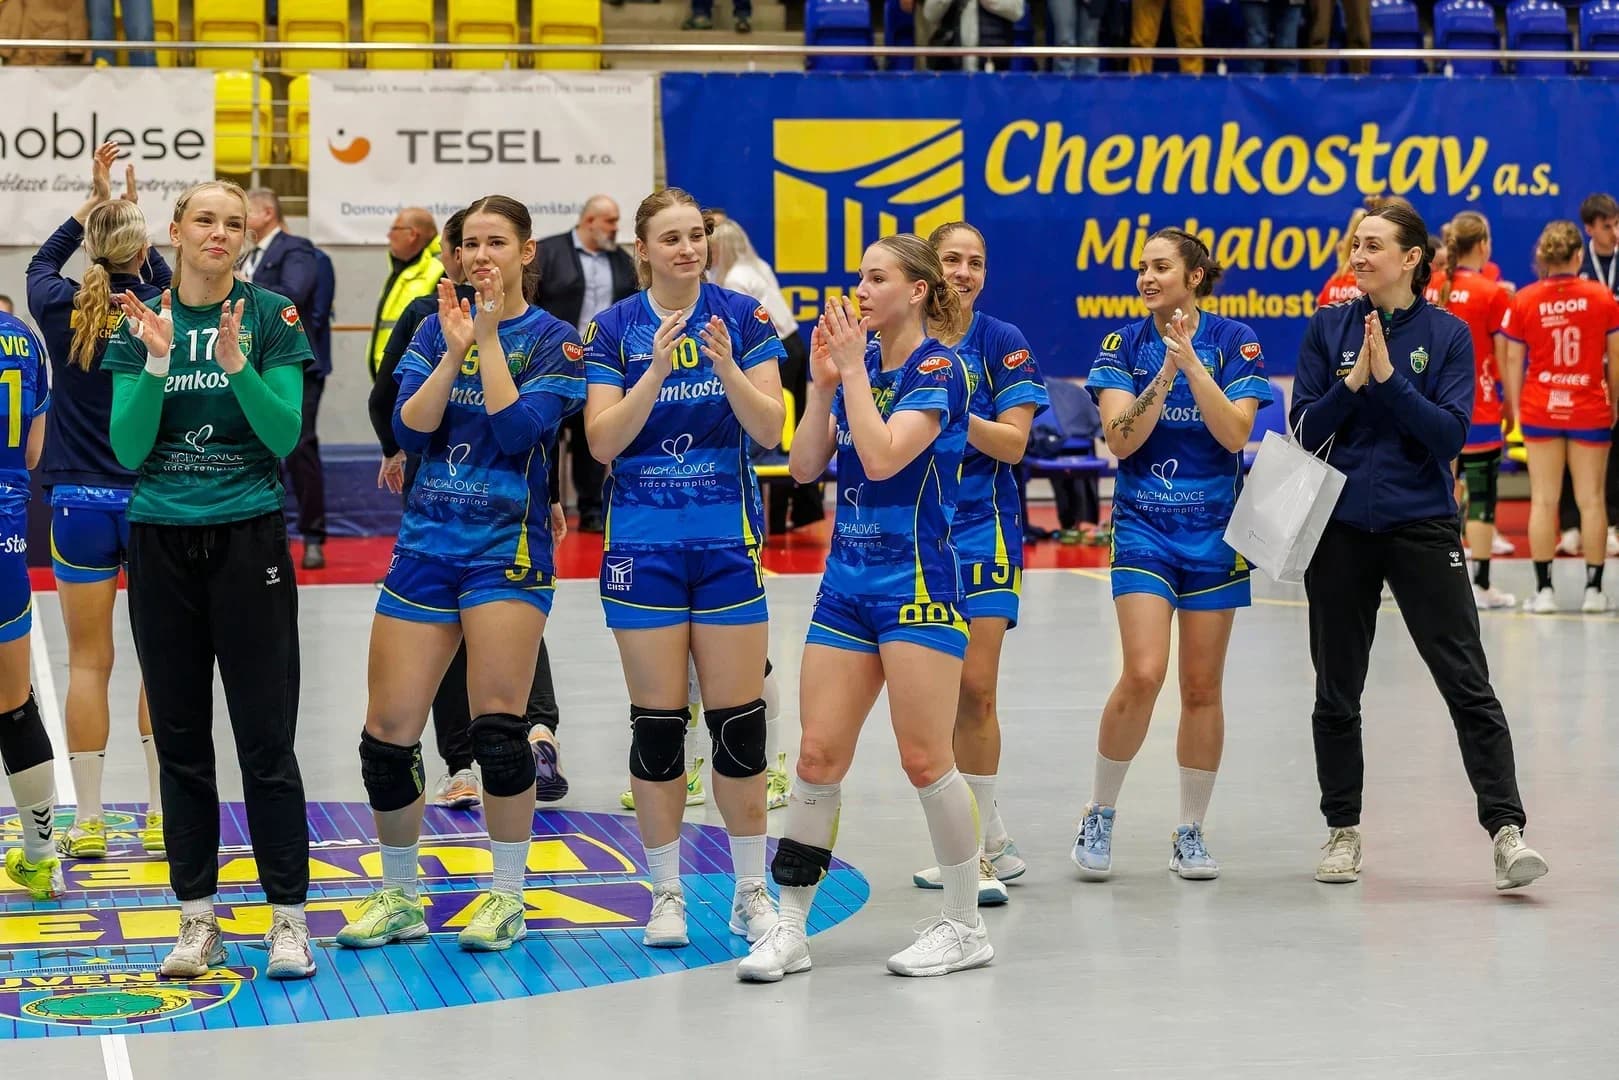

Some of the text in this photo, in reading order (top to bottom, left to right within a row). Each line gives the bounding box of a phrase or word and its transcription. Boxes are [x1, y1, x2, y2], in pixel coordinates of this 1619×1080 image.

[0, 112, 205, 160] oblese
[396, 130, 616, 165] TESEL s.r.o.
[984, 119, 1560, 202] Chemkostav, a.s.
[1076, 214, 1342, 272] Mihalov
[1425, 287, 1470, 304] FLOR
[1539, 297, 1589, 315] FLOOR
[0, 335, 29, 357] VIC
[186, 327, 219, 362] 17
[1551, 326, 1581, 367] 16
[164, 370, 230, 393] emkos
[640, 462, 716, 475] MICHALOVCE
